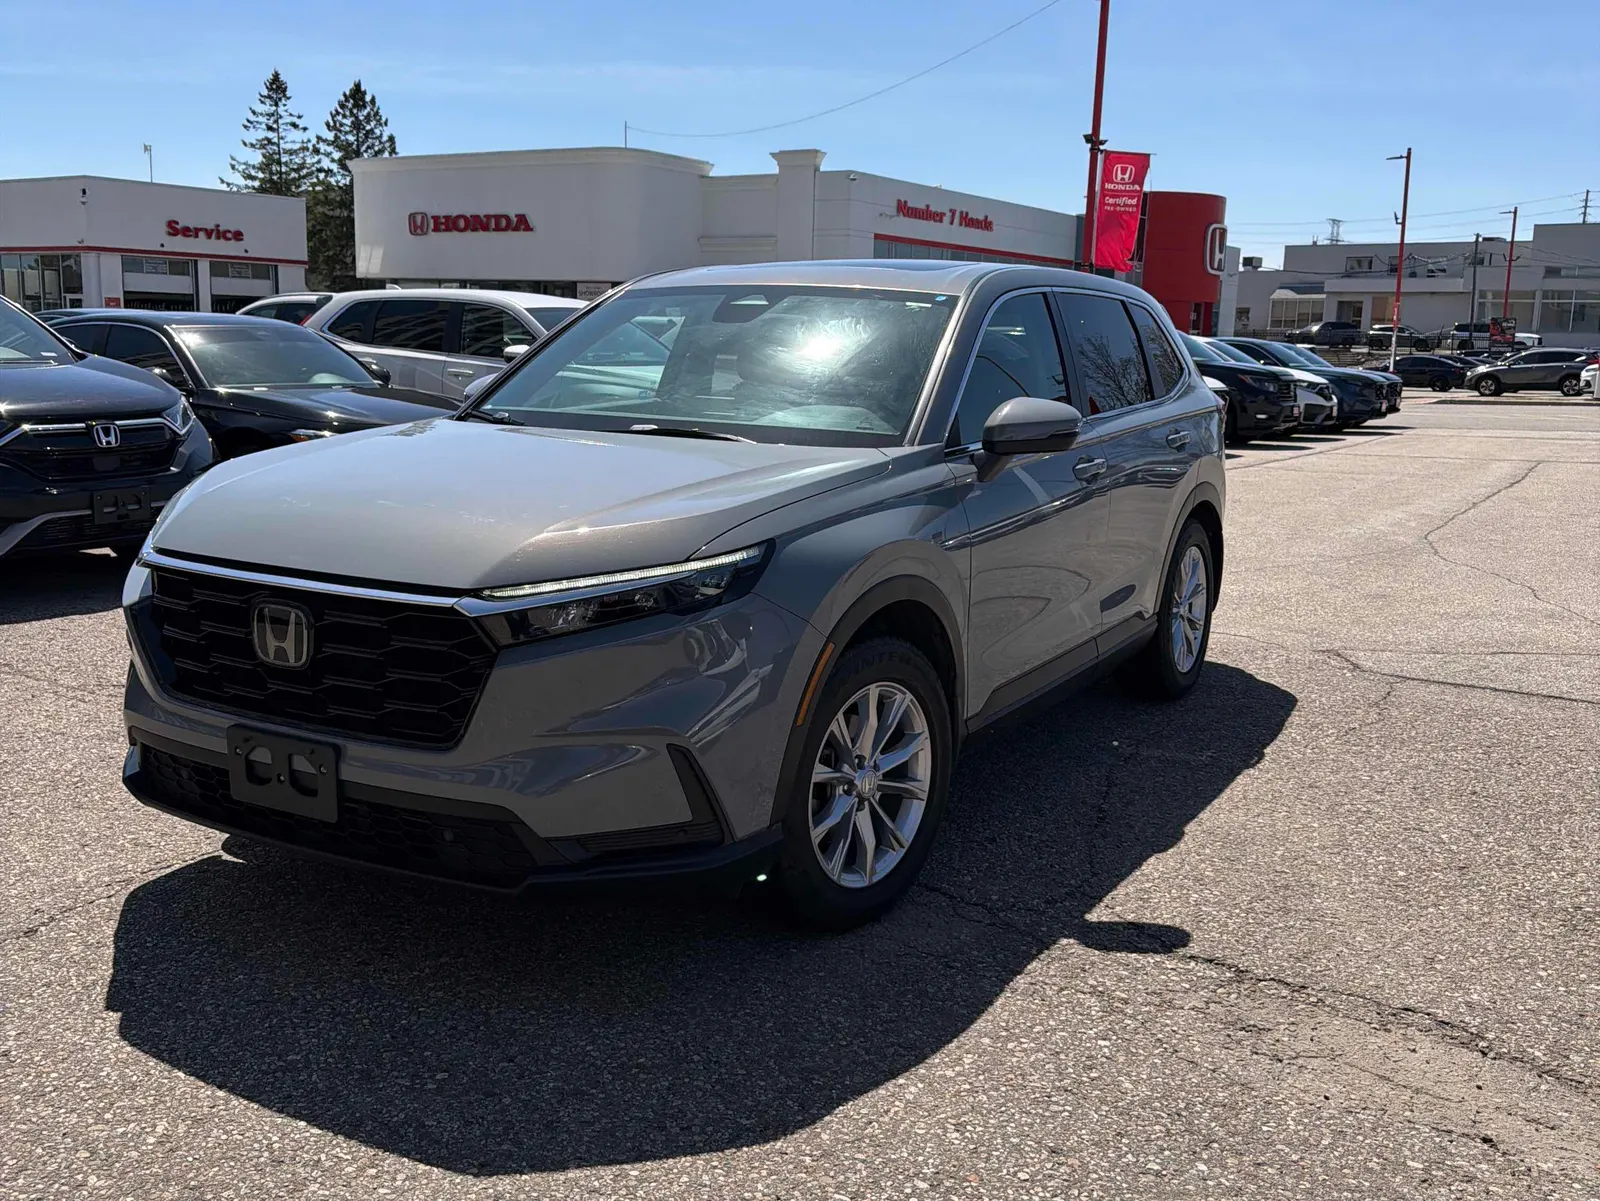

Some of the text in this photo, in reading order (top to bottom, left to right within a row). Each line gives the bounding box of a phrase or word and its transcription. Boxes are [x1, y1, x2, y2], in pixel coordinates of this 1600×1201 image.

[1105, 183, 1140, 191] HONDA
[1105, 196, 1137, 206] Certified
[430, 213, 535, 232] HONDA
[896, 199, 994, 232] Number 7 Honda
[165, 219, 244, 242] Service
